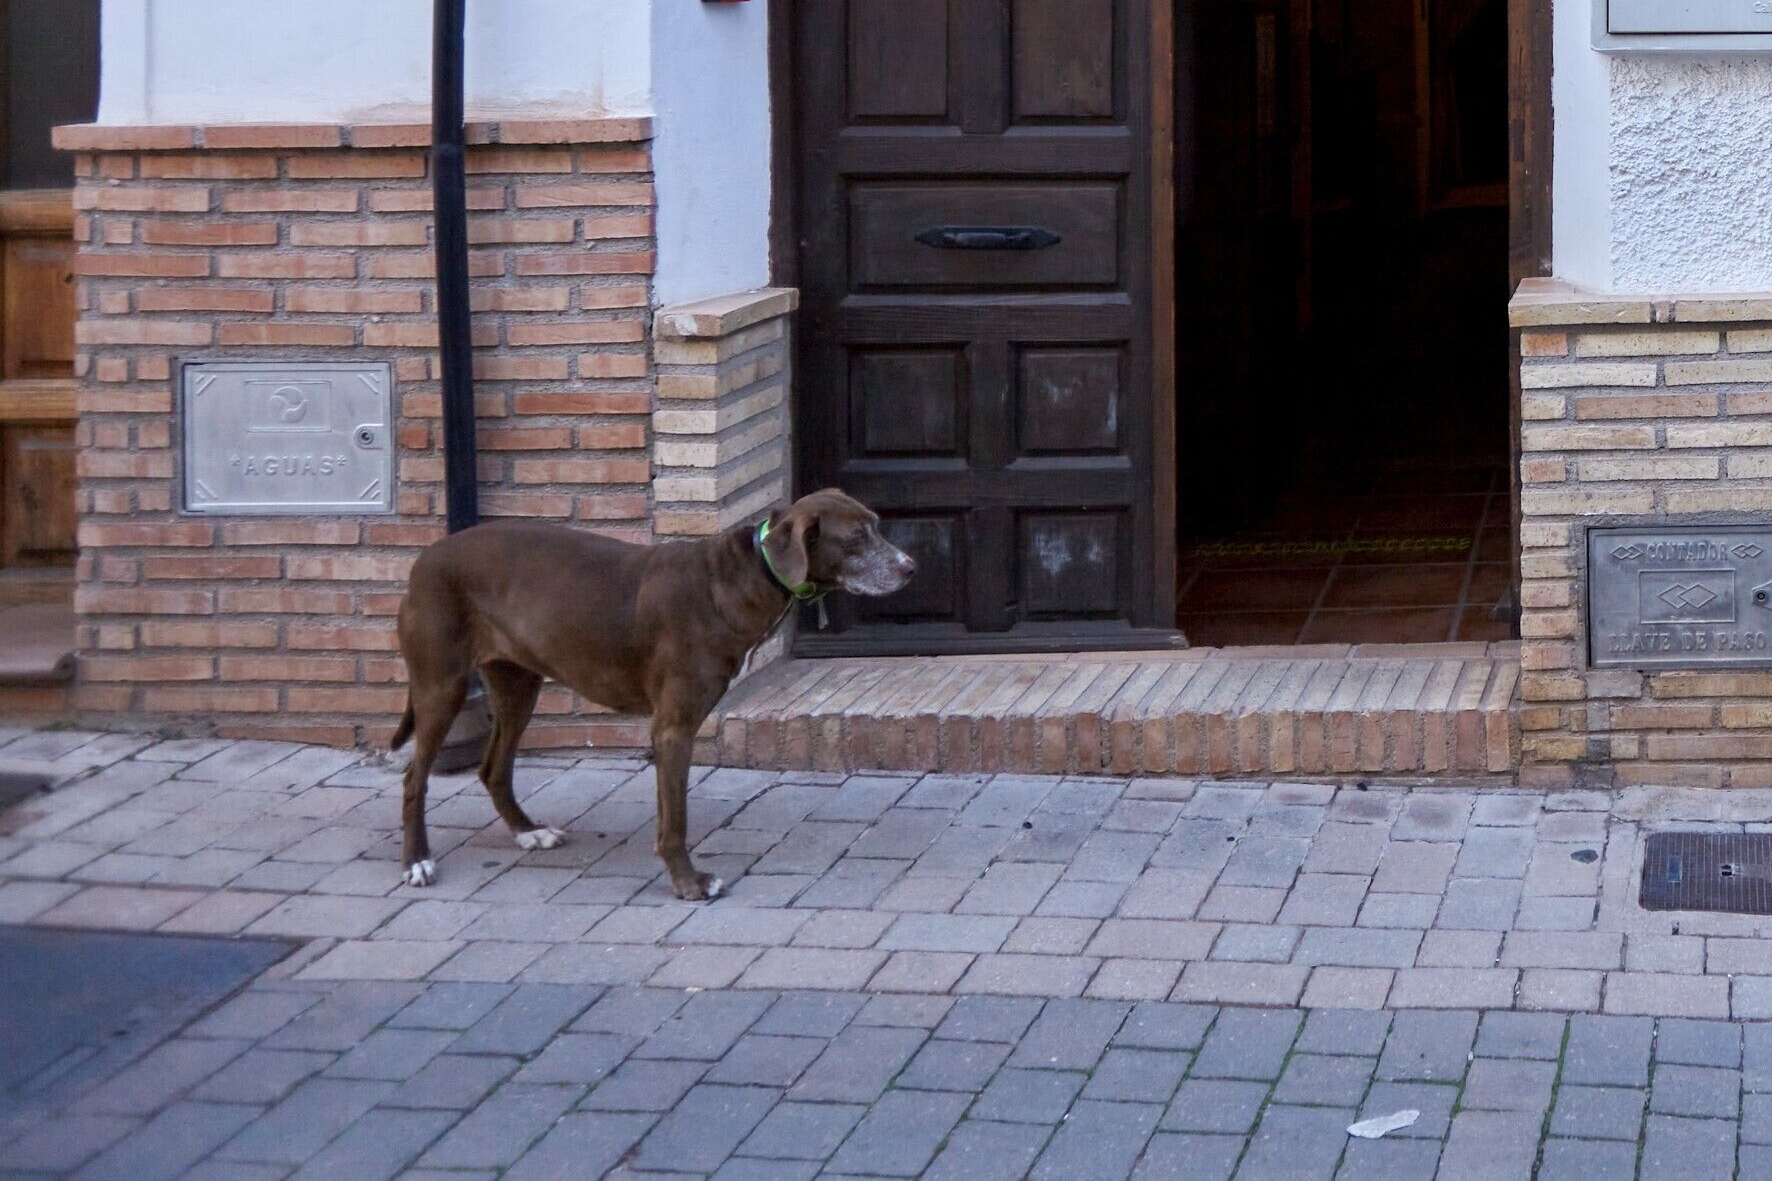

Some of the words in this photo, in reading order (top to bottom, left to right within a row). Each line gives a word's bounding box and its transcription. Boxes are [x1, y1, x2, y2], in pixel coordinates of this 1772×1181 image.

[1646, 542, 1728, 562] CONTADOR
[1607, 633, 1672, 654] LLAVE
[1681, 632, 1707, 652] DE
[1716, 630, 1767, 652] PASO
